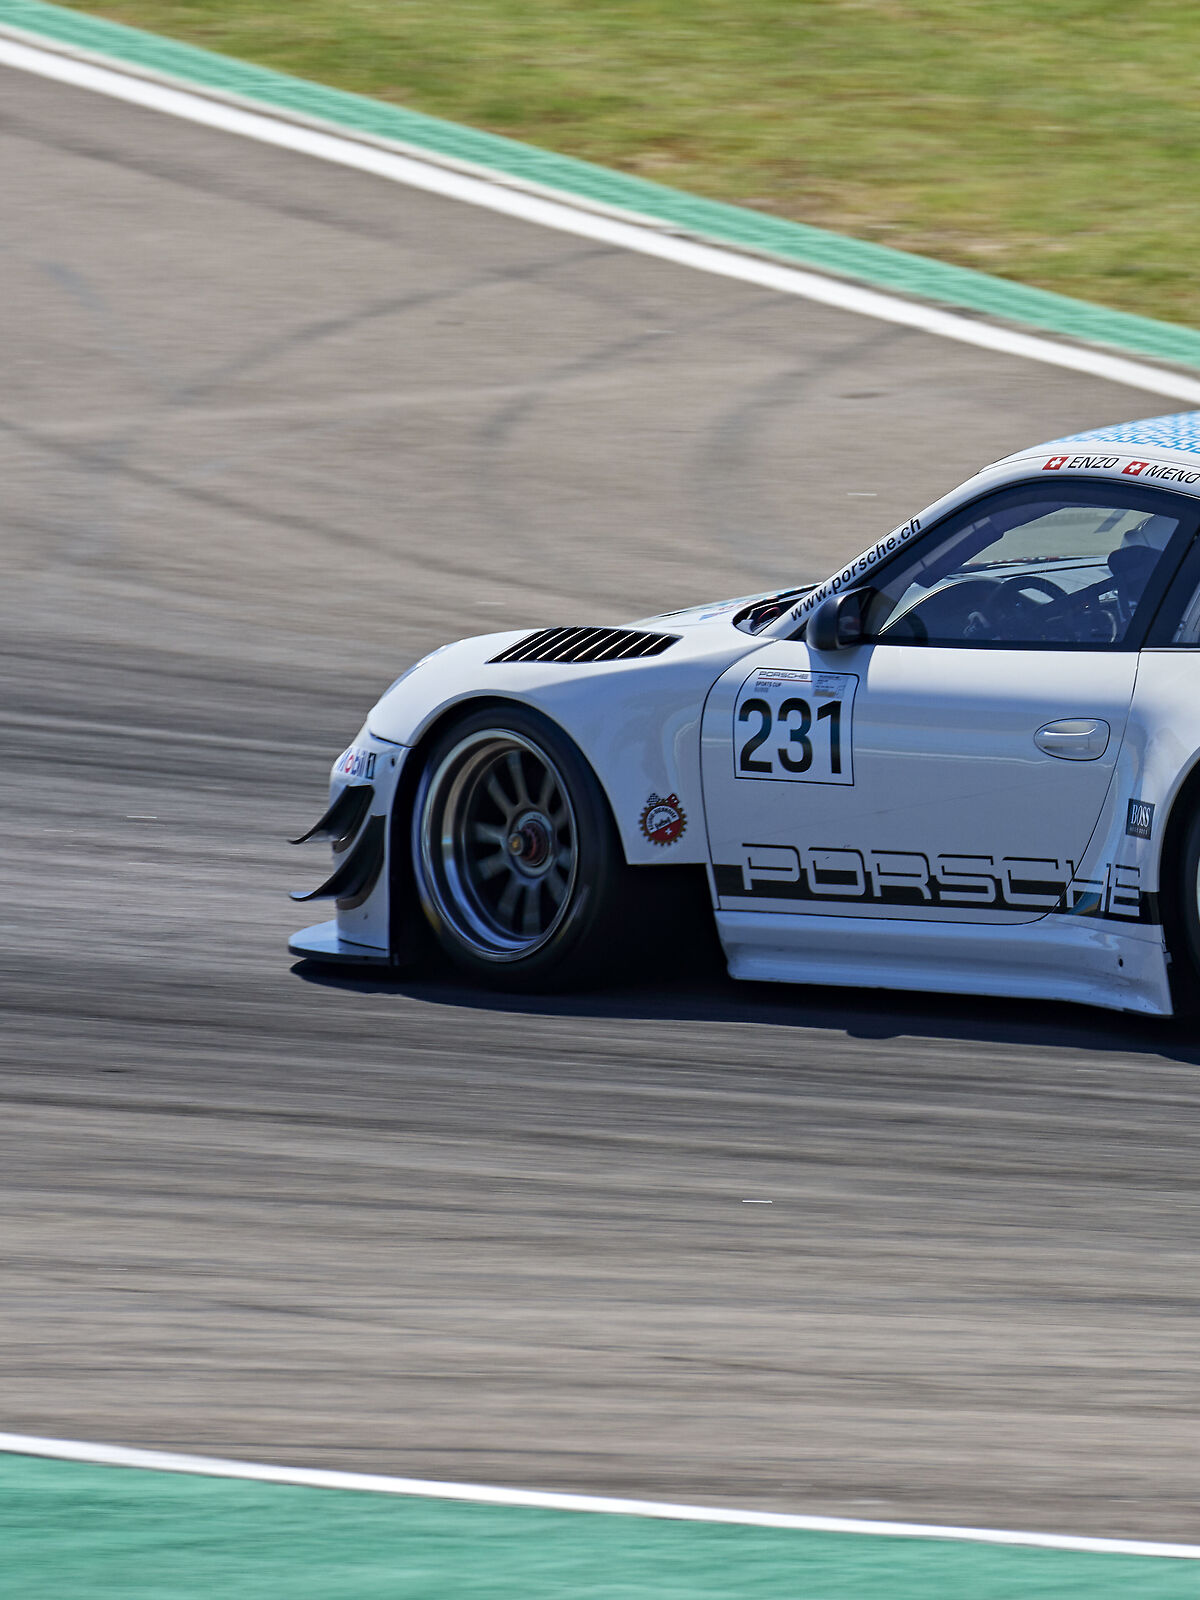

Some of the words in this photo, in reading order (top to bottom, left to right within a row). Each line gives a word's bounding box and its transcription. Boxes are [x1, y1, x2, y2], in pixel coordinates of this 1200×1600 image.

[1067, 456, 1120, 469] ENZO
[791, 518, 921, 621] www.porsche.ch
[759, 671, 809, 680] PORSCHE
[738, 697, 842, 774] 231
[1130, 804, 1151, 827] BOSS
[741, 843, 1141, 917] PORSCHE
